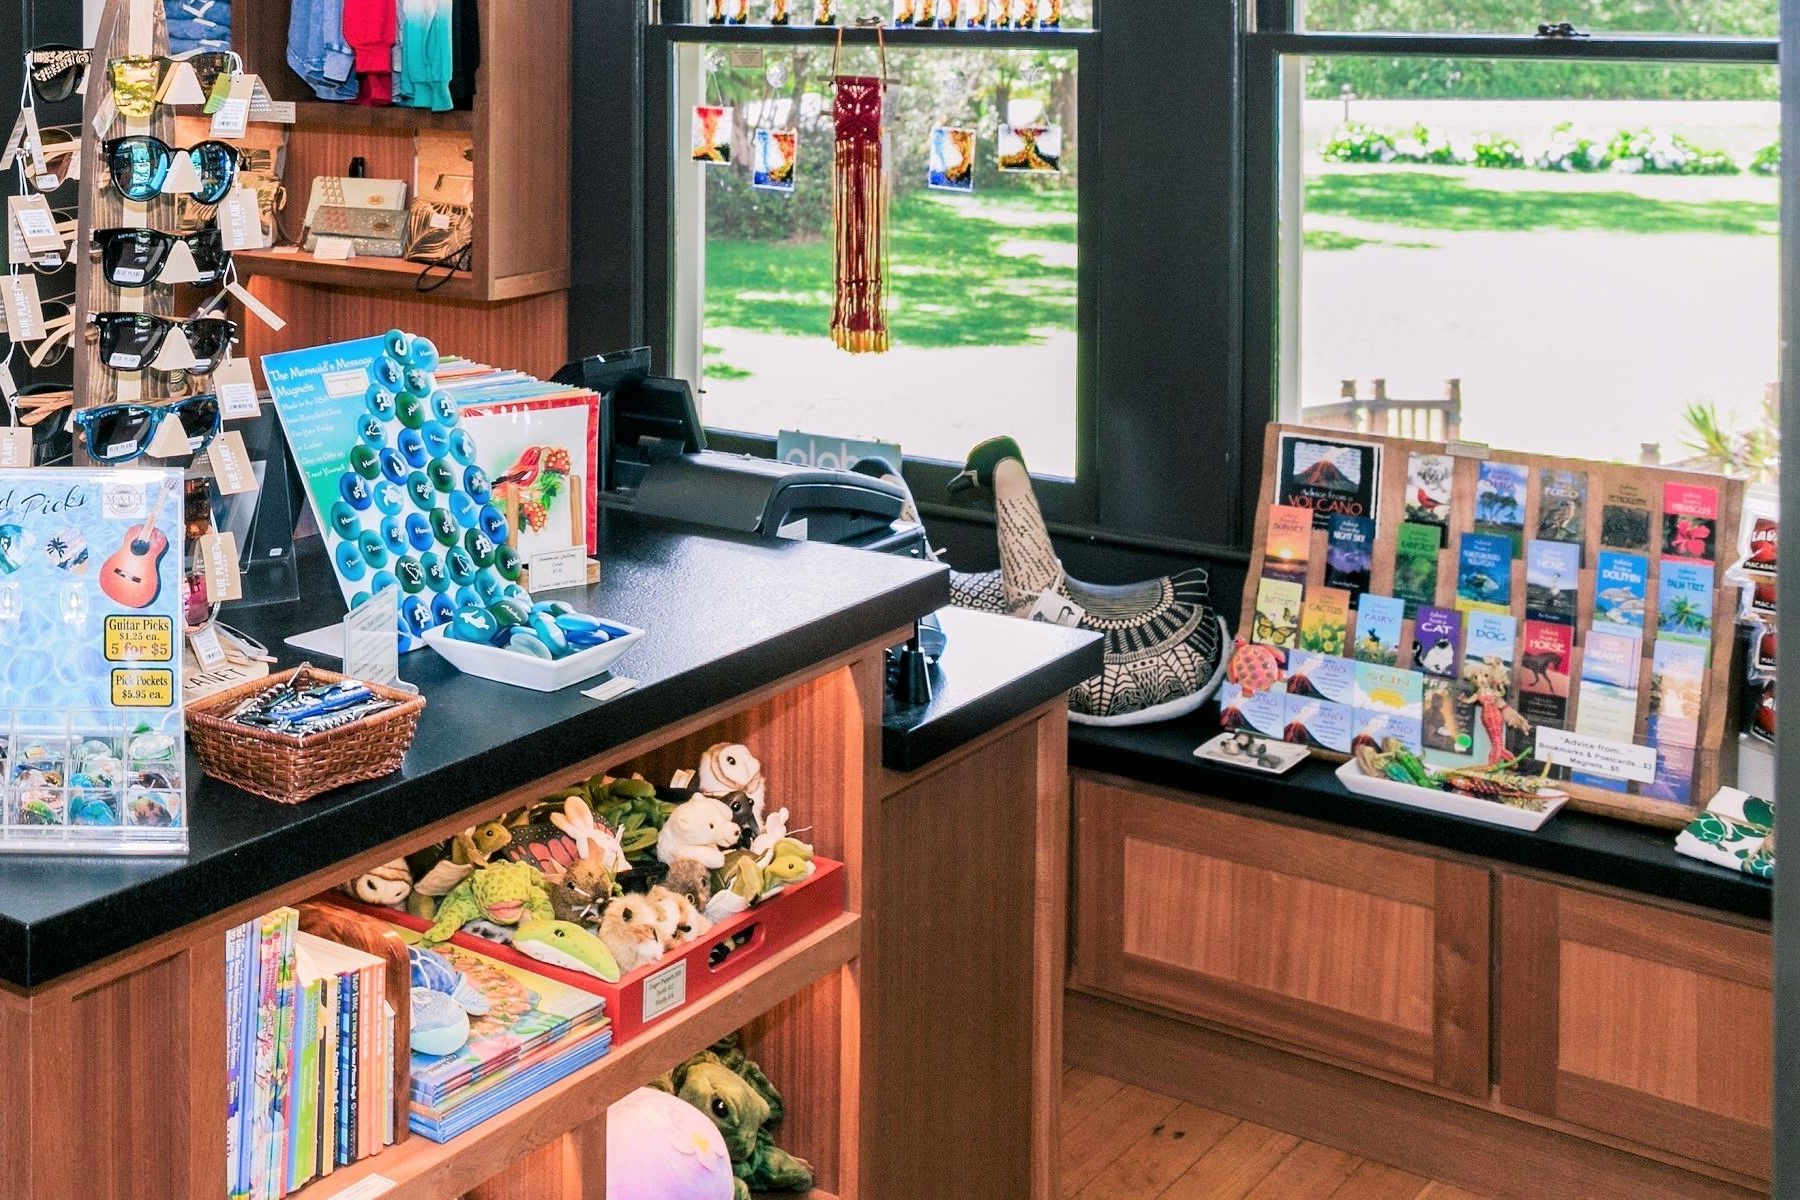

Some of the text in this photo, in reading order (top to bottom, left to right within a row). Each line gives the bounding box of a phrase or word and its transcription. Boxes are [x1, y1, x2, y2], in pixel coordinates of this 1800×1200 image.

[15, 288, 31, 337] PLANET BLUE
[269, 356, 374, 382] The Mermaid's Message
[276, 383, 314, 398] Magnets
[282, 402, 298, 410] Made
[1, 437, 14, 466] PLANET
[785, 439, 860, 471] aloh
[219, 443, 243, 490] PLANET BLUE
[306, 464, 346, 479] Treat Yourself
[1301, 488, 1326, 499] Advice
[20, 484, 88, 521] Picks
[1288, 494, 1363, 516] VOLCANO
[214, 544, 226, 597] PLANET BLUE
[1602, 569, 1641, 584] DOLPHIN
[1309, 602, 1343, 616] CACTUS
[108, 619, 169, 632] Guitar Picks
[1364, 613, 1394, 625] FAIRY
[1421, 622, 1452, 634] CAT
[1476, 628, 1507, 642] DOG
[119, 632, 160, 641] $1.25 ea.
[111, 642, 168, 656] 5 for $5
[1529, 638, 1565, 650] HORSE
[1591, 650, 1625, 662] WAVE
[115, 675, 168, 687] Pick Pockets
[121, 689, 164, 700] $5.95 ea.
[1538, 742, 1585, 758] Bookmarks
